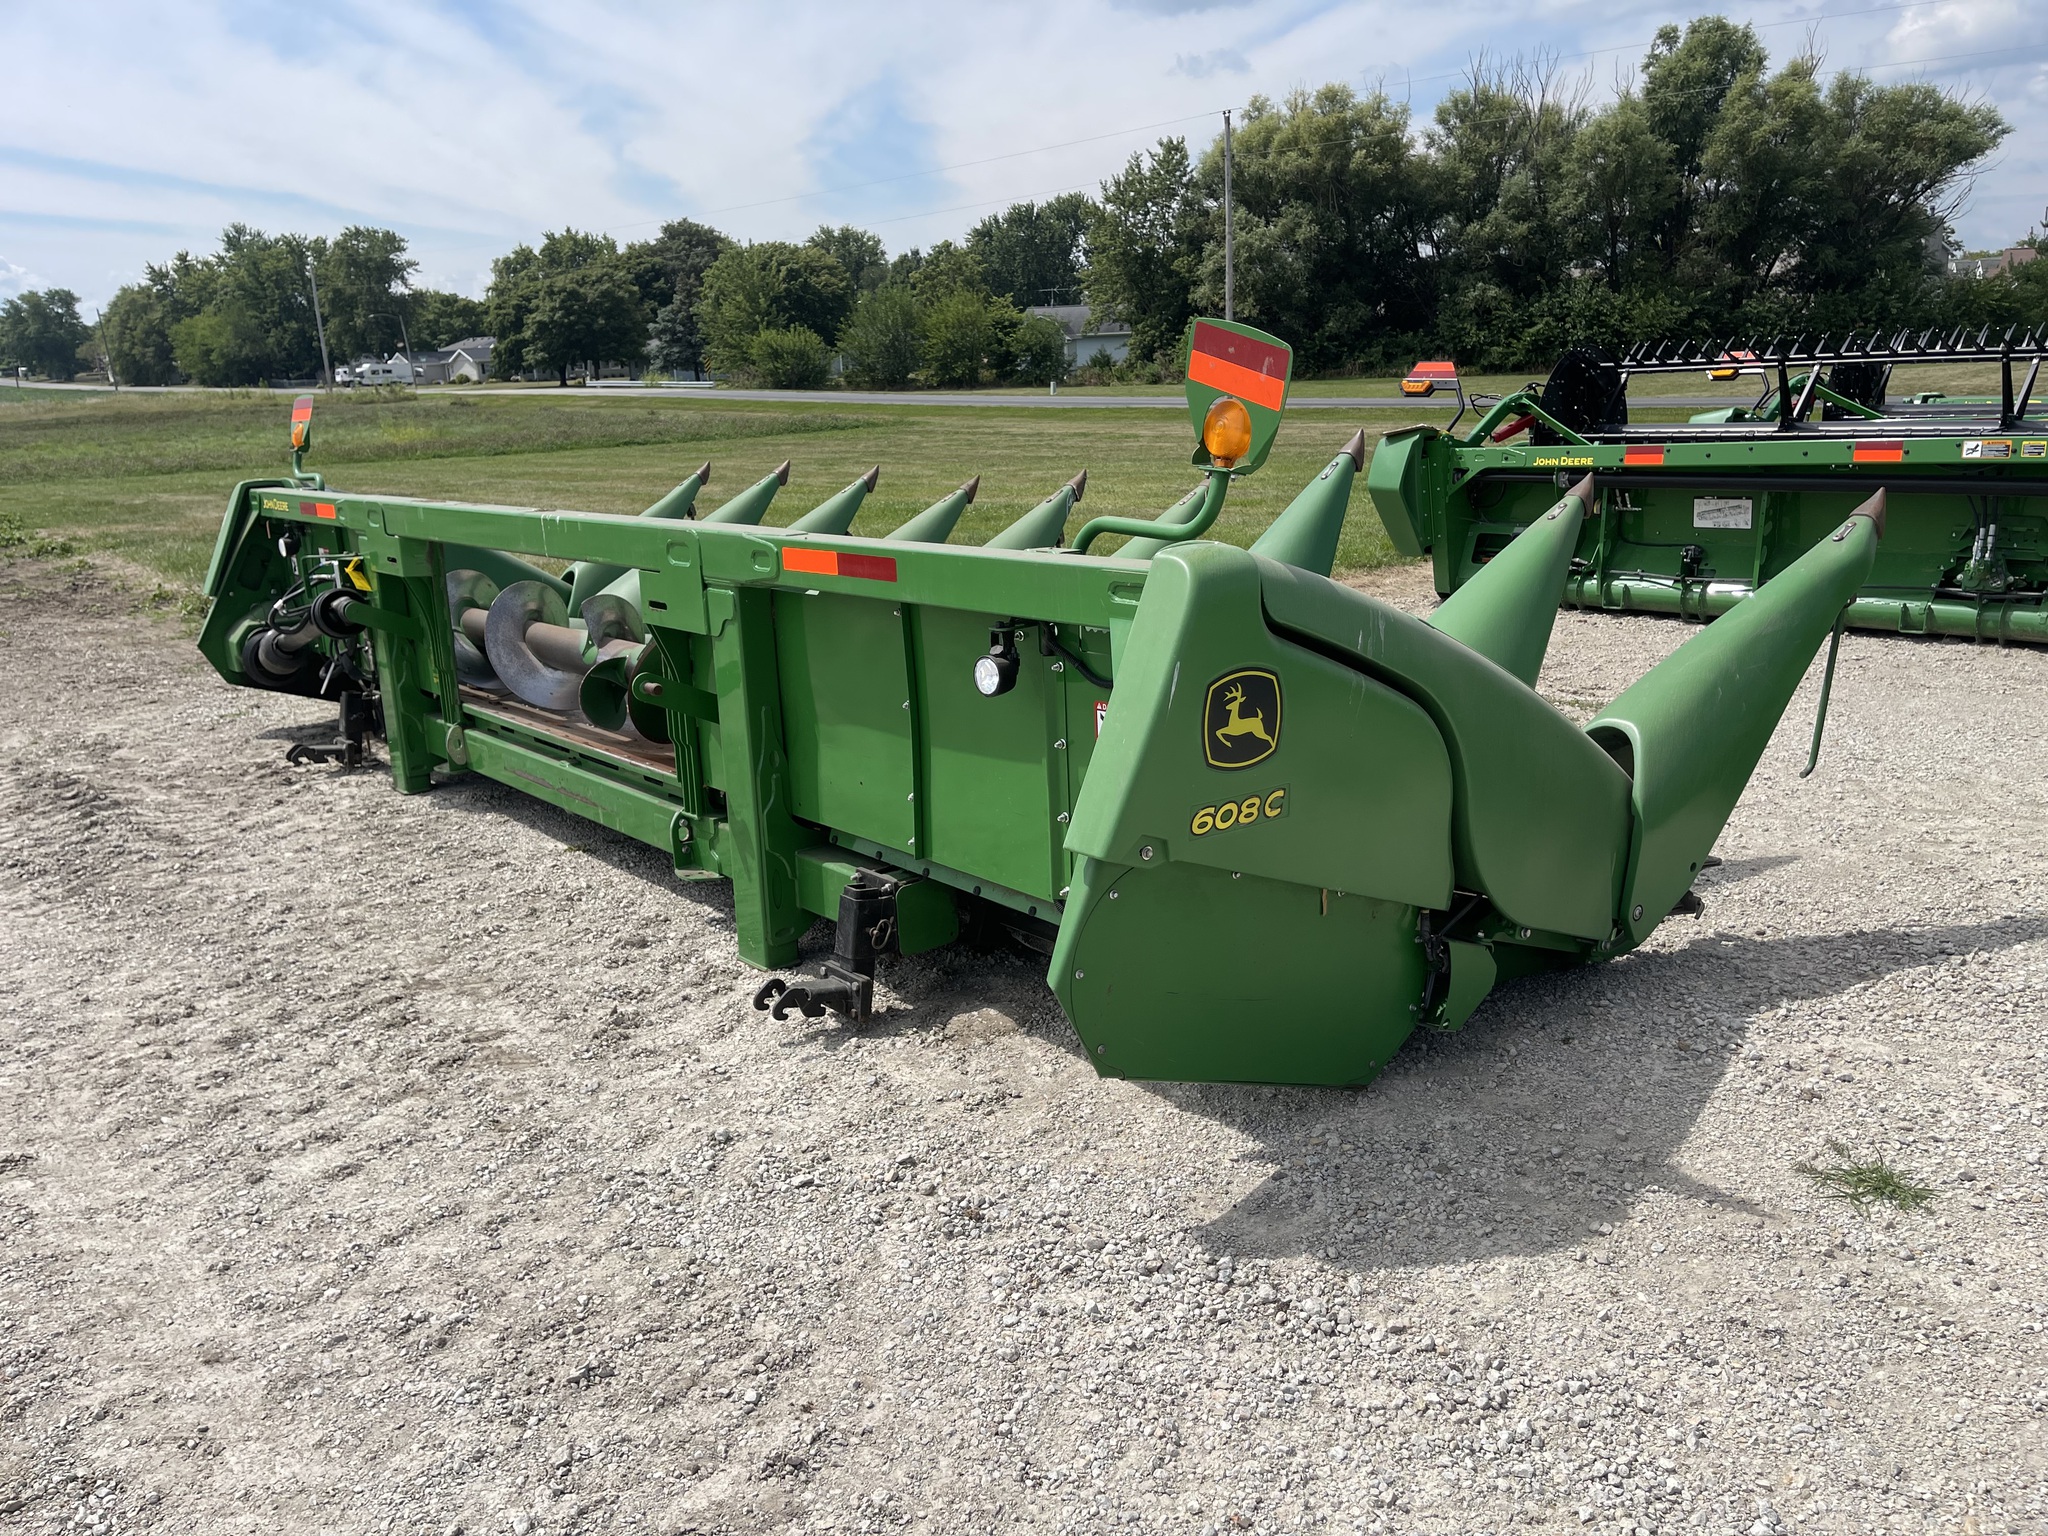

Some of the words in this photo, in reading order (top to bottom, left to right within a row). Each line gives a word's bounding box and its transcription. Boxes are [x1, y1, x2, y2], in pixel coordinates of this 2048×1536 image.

[1533, 457, 1559, 466] JOHN
[1560, 456, 1594, 466] DEERE
[1191, 788, 1286, 836] 608C
